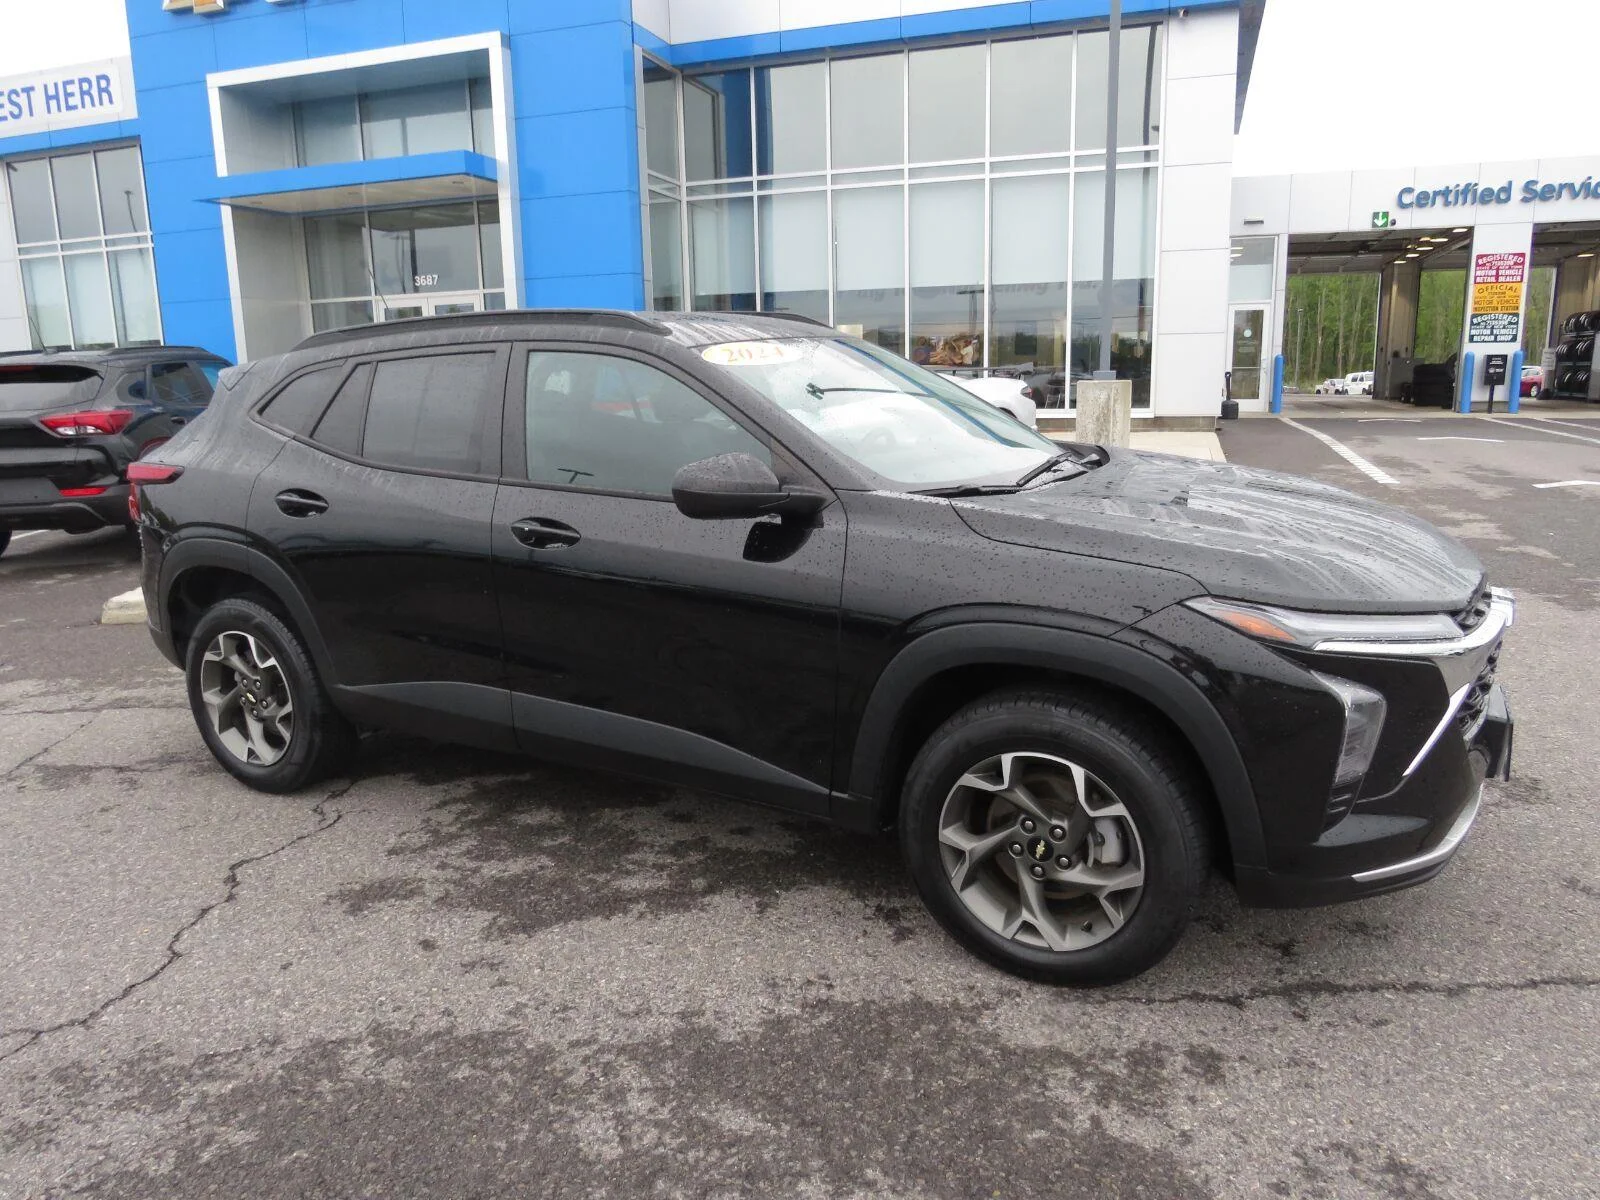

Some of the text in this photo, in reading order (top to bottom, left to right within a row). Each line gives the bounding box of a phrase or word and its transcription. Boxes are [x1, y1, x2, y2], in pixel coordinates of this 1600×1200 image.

[43, 74, 114, 114] HERR
[1397, 180, 1512, 209] Certified
[1477, 254, 1523, 265] REGISTERED
[414, 274, 439, 287] 3687
[1498, 275, 1521, 283] DEALER
[1477, 284, 1518, 294] OFFICIAL
[1472, 313, 1518, 325] REGISTERED
